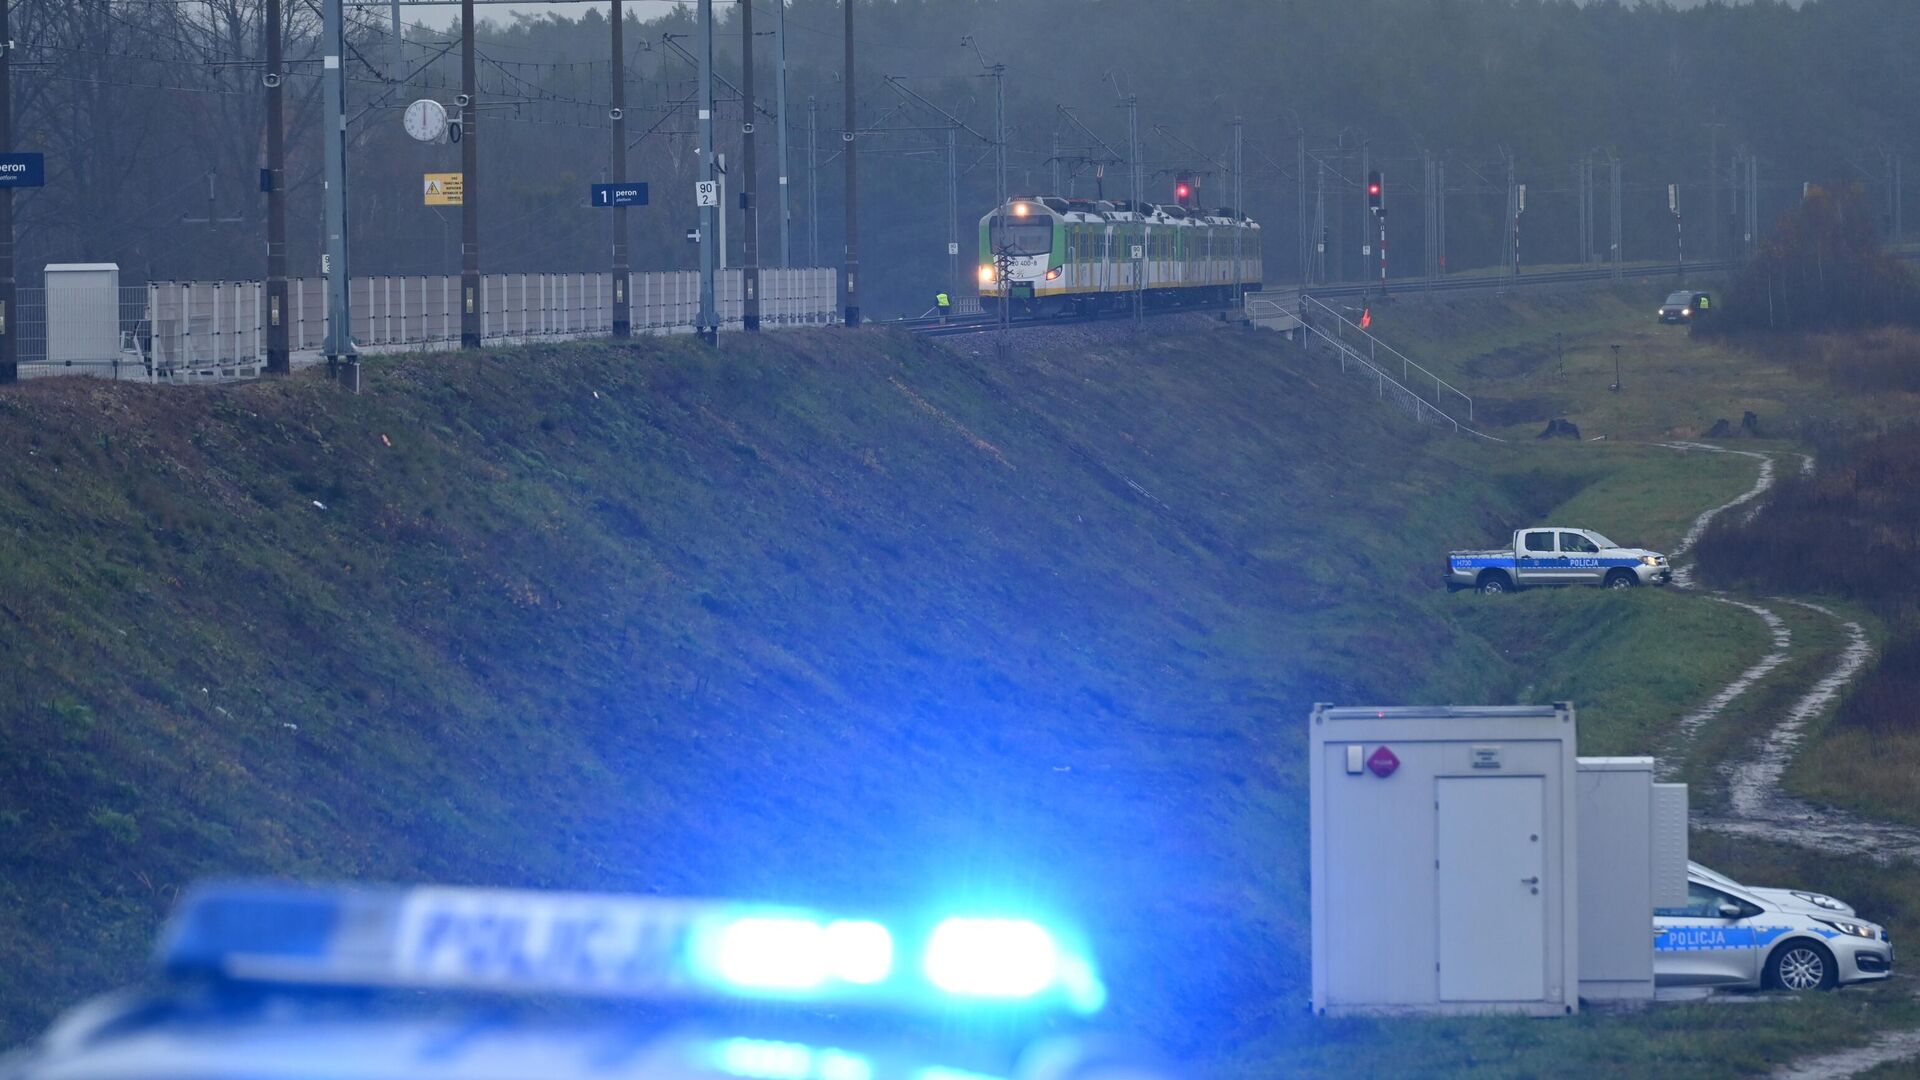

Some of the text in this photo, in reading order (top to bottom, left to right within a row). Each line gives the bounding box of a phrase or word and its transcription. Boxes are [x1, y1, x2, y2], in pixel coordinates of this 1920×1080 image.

[0, 164, 26, 172] eron
[700, 183, 712, 193] 90
[601, 190, 607, 203] 1
[703, 195, 708, 204] 2
[1570, 559, 1599, 567] POLICJA
[1669, 931, 1726, 946] POLICJA
